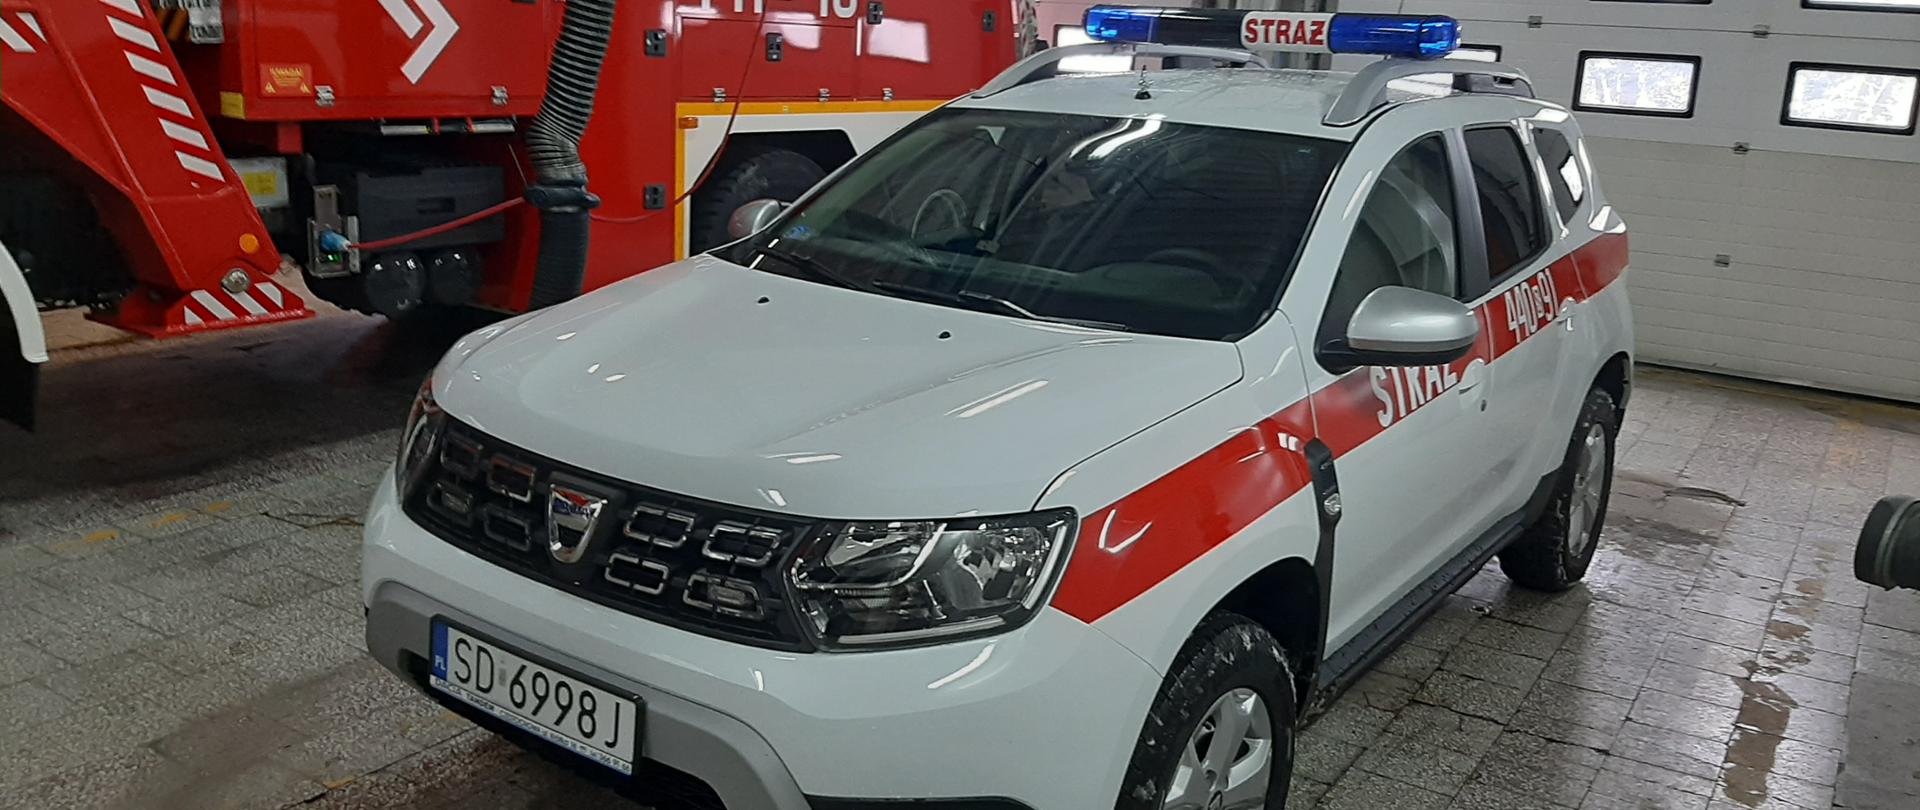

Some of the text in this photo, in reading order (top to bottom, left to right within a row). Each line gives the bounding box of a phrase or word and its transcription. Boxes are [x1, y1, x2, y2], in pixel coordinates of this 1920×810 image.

[434, 654, 446, 671] PL
[454, 637, 621, 749] SD 6998J
